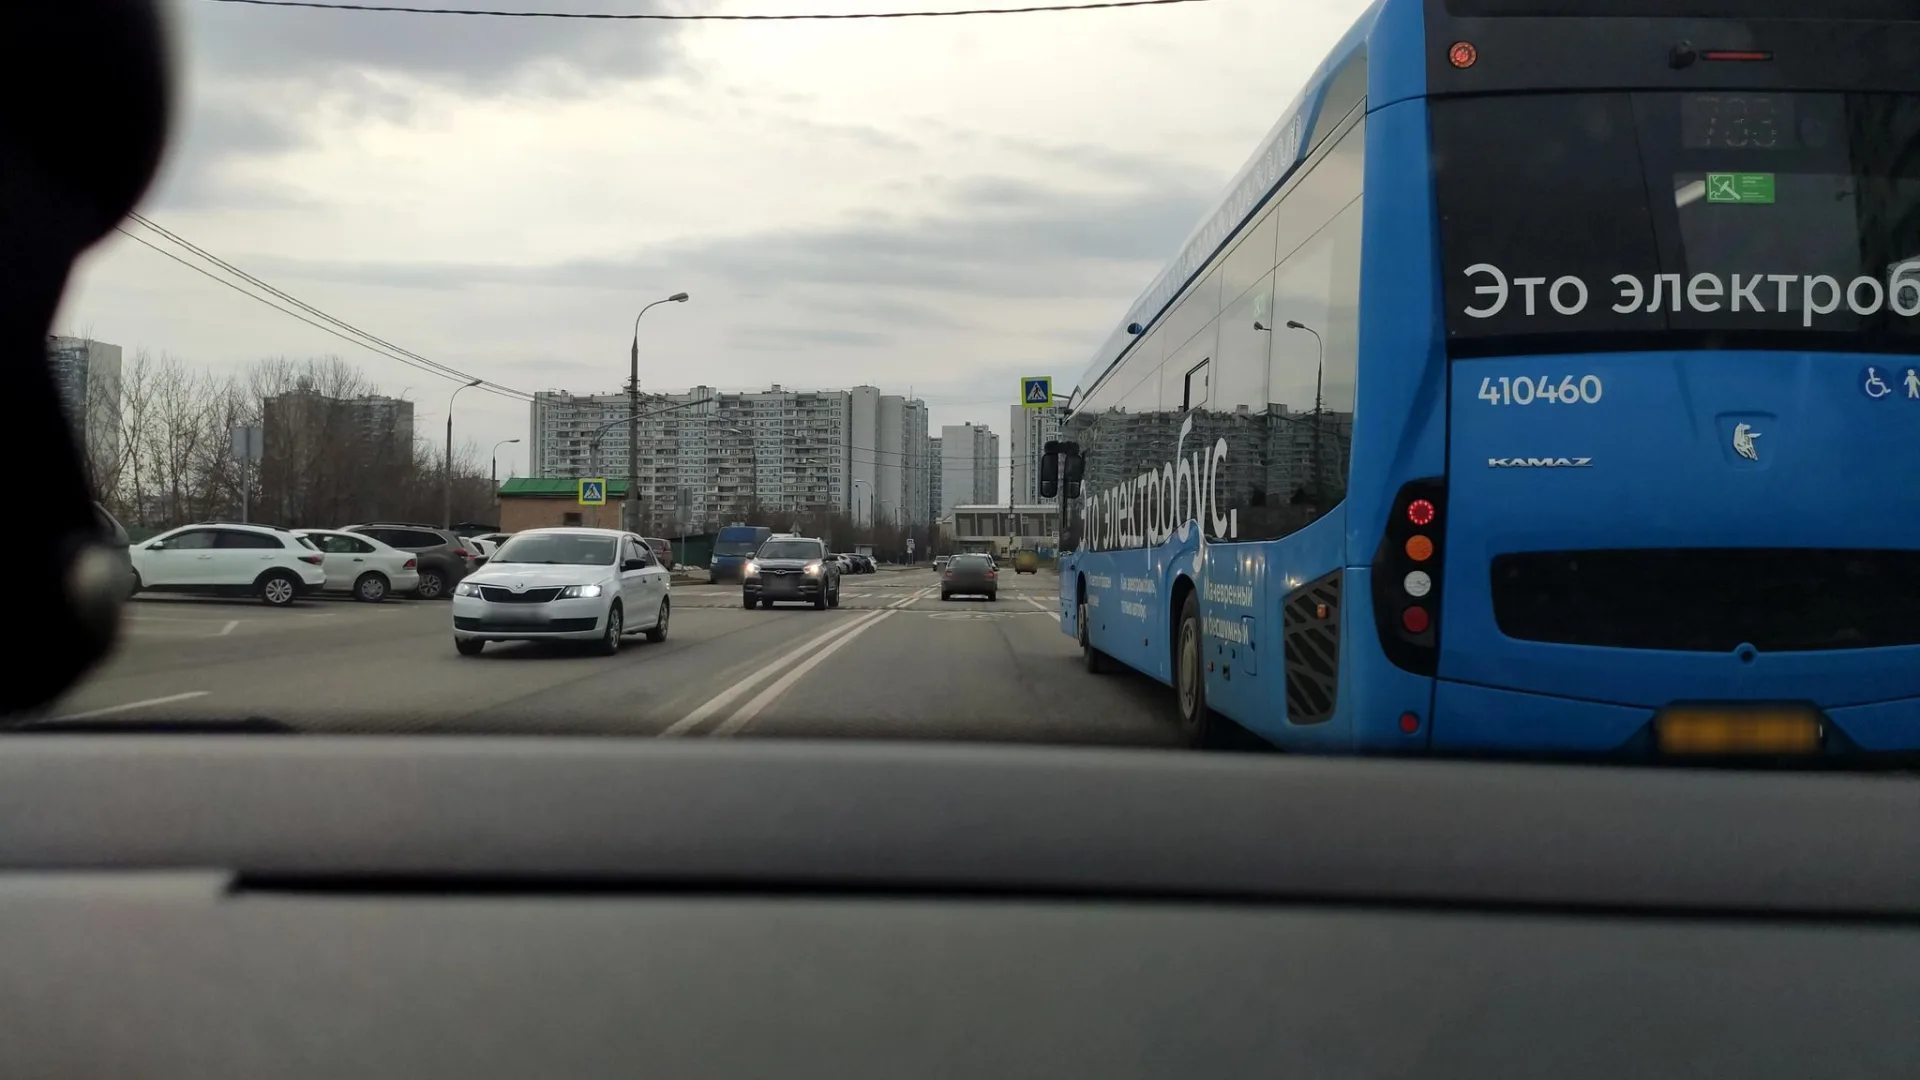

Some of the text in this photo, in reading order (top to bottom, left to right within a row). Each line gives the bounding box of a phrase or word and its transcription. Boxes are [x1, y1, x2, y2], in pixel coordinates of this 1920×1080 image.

[1463, 260, 1920, 327] Это электроб
[1477, 374, 1603, 405] 410460
[1487, 456, 1593, 468] KAMAZ
[1079, 415, 1237, 573] Это электробус.
